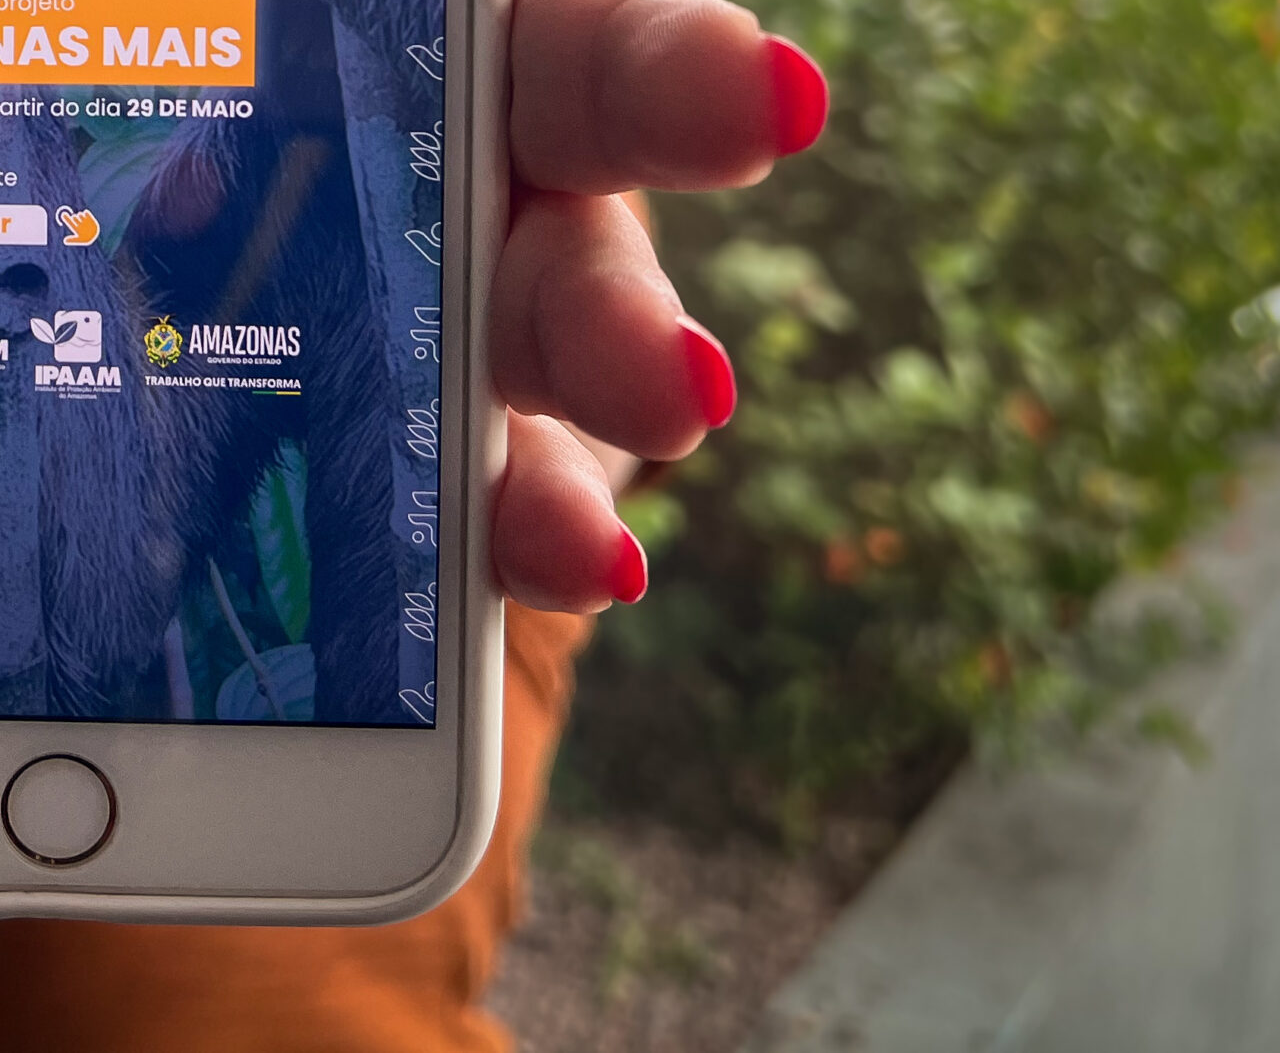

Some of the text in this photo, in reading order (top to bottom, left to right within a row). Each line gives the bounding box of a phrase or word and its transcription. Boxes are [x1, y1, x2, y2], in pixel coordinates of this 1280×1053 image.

[102, 26, 242, 67] MAIS
[50, 98, 79, 116] do
[85, 98, 121, 117] dia
[126, 99, 154, 117] 29
[159, 99, 187, 117] DE
[192, 99, 254, 118] MAIO
[188, 324, 301, 357] AMAZONAS
[207, 357, 241, 365] GOVERNO
[242, 357, 254, 365] DO
[35, 365, 122, 386] IPAAM
[145, 376, 302, 389] TRABALHO QUE TRANSFORMA
